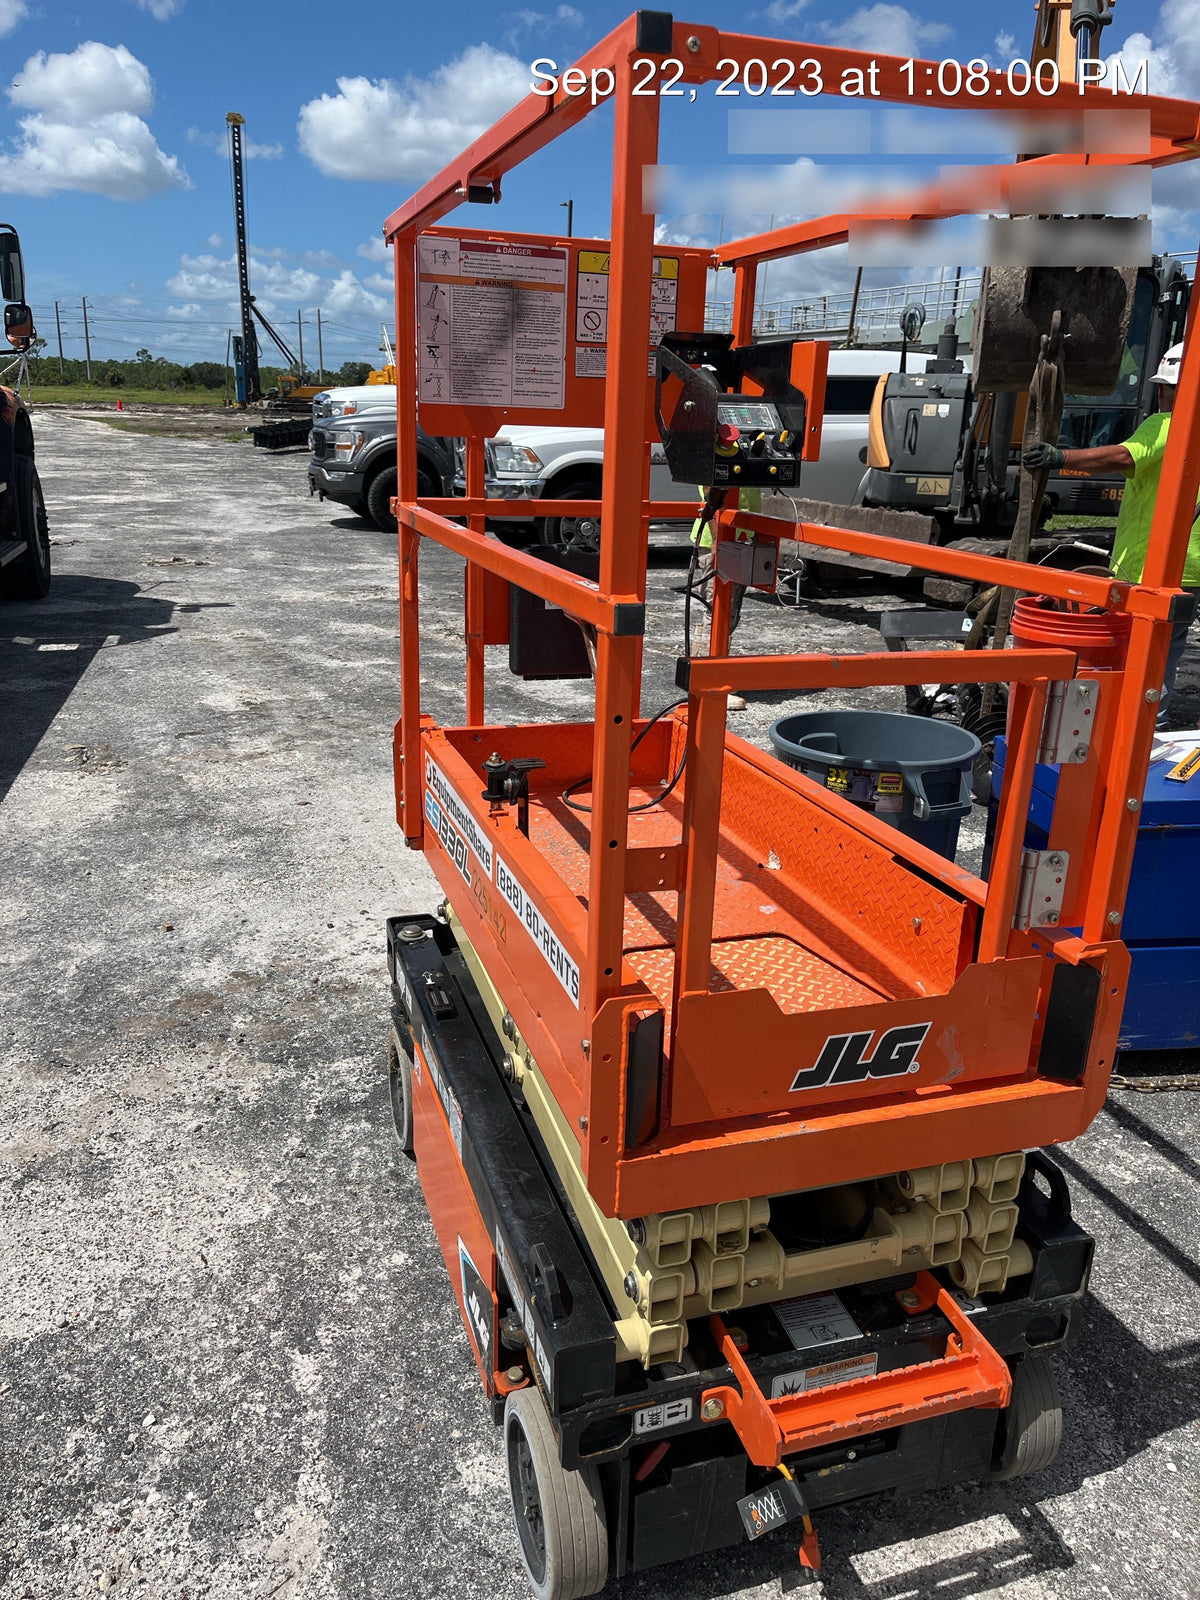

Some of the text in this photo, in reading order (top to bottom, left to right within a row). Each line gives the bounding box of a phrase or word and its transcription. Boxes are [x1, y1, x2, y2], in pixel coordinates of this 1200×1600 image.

[502, 246, 532, 256] DANGER
[481, 280, 514, 289] WARNING
[827, 767, 849, 785] 3X
[432, 765, 492, 873] EquipmentShare
[497, 860, 579, 1001] (888) 80-RENTS
[826, 1358, 864, 1372] WARNING
